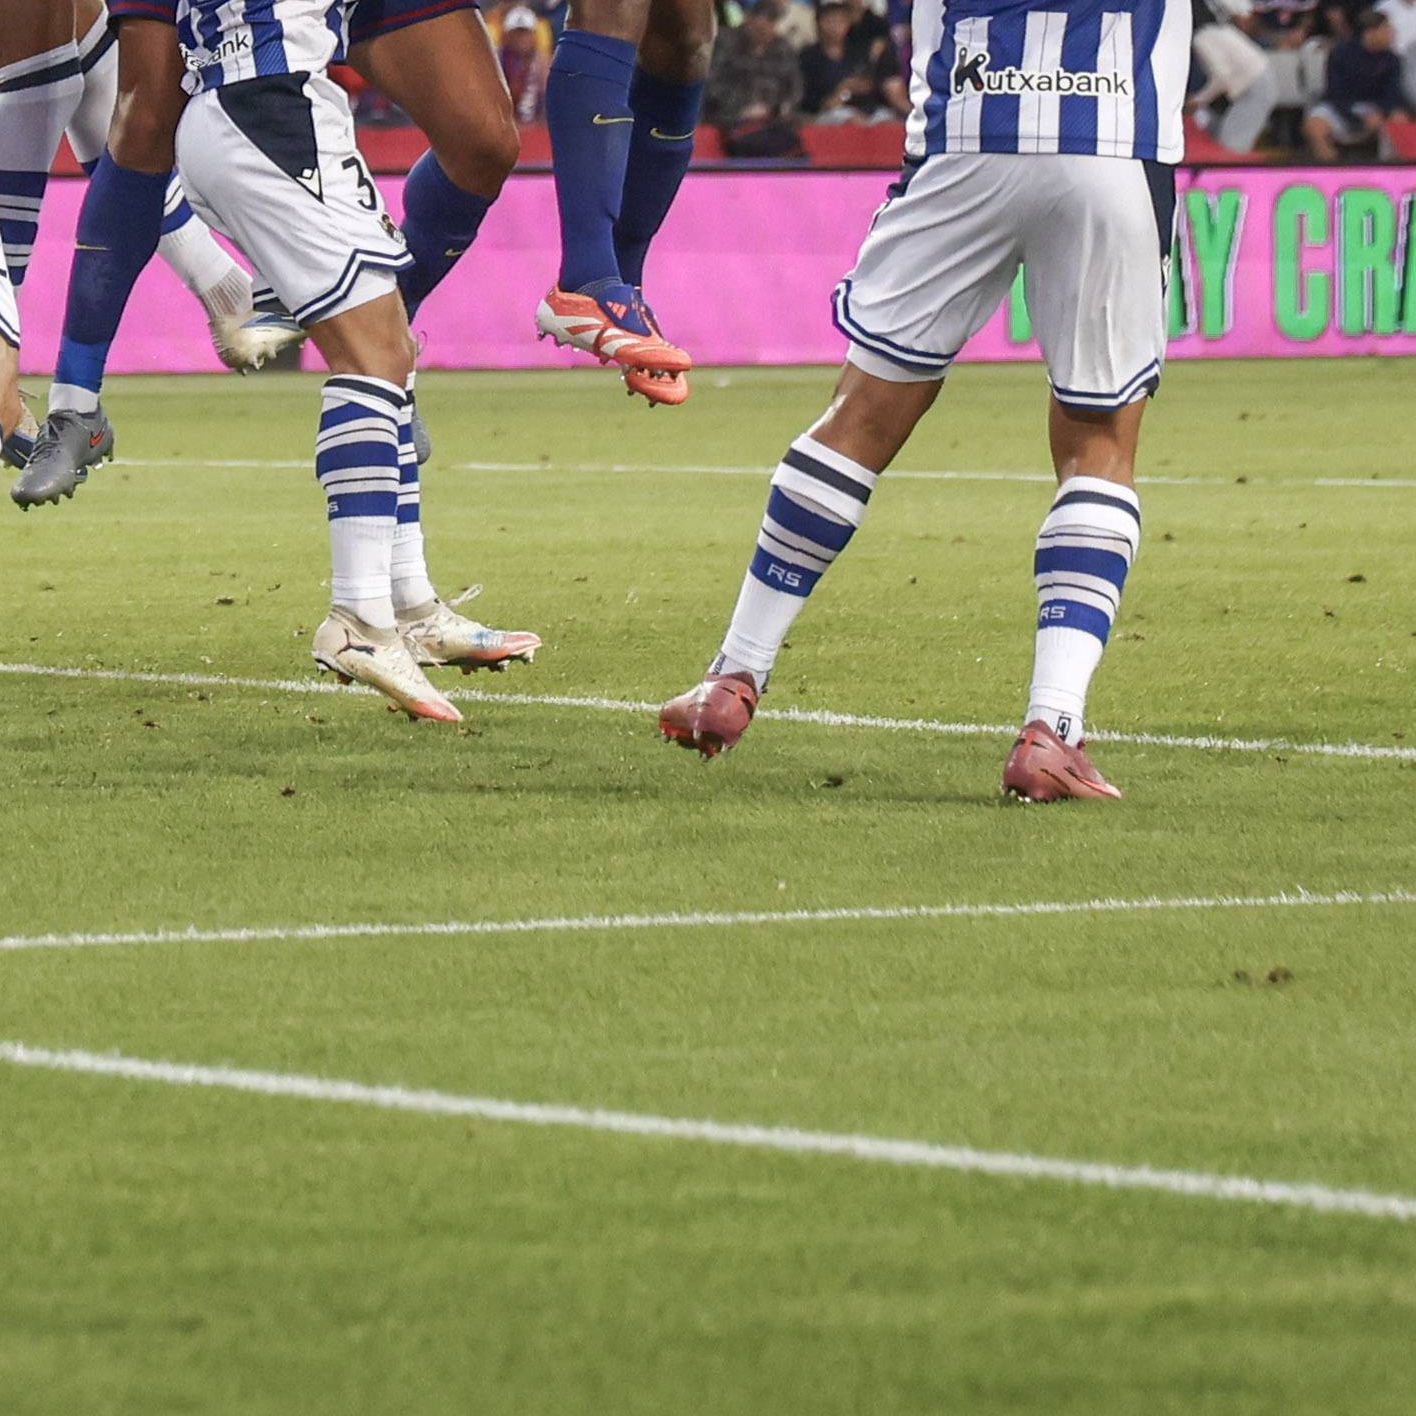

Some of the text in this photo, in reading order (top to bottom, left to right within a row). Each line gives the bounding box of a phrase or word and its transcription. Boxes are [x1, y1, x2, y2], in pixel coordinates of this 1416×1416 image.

[954, 47, 1129, 95] Kutxabank
[341, 155, 377, 211] 3
[767, 563, 803, 588] RS
[1039, 606, 1067, 622] RS
